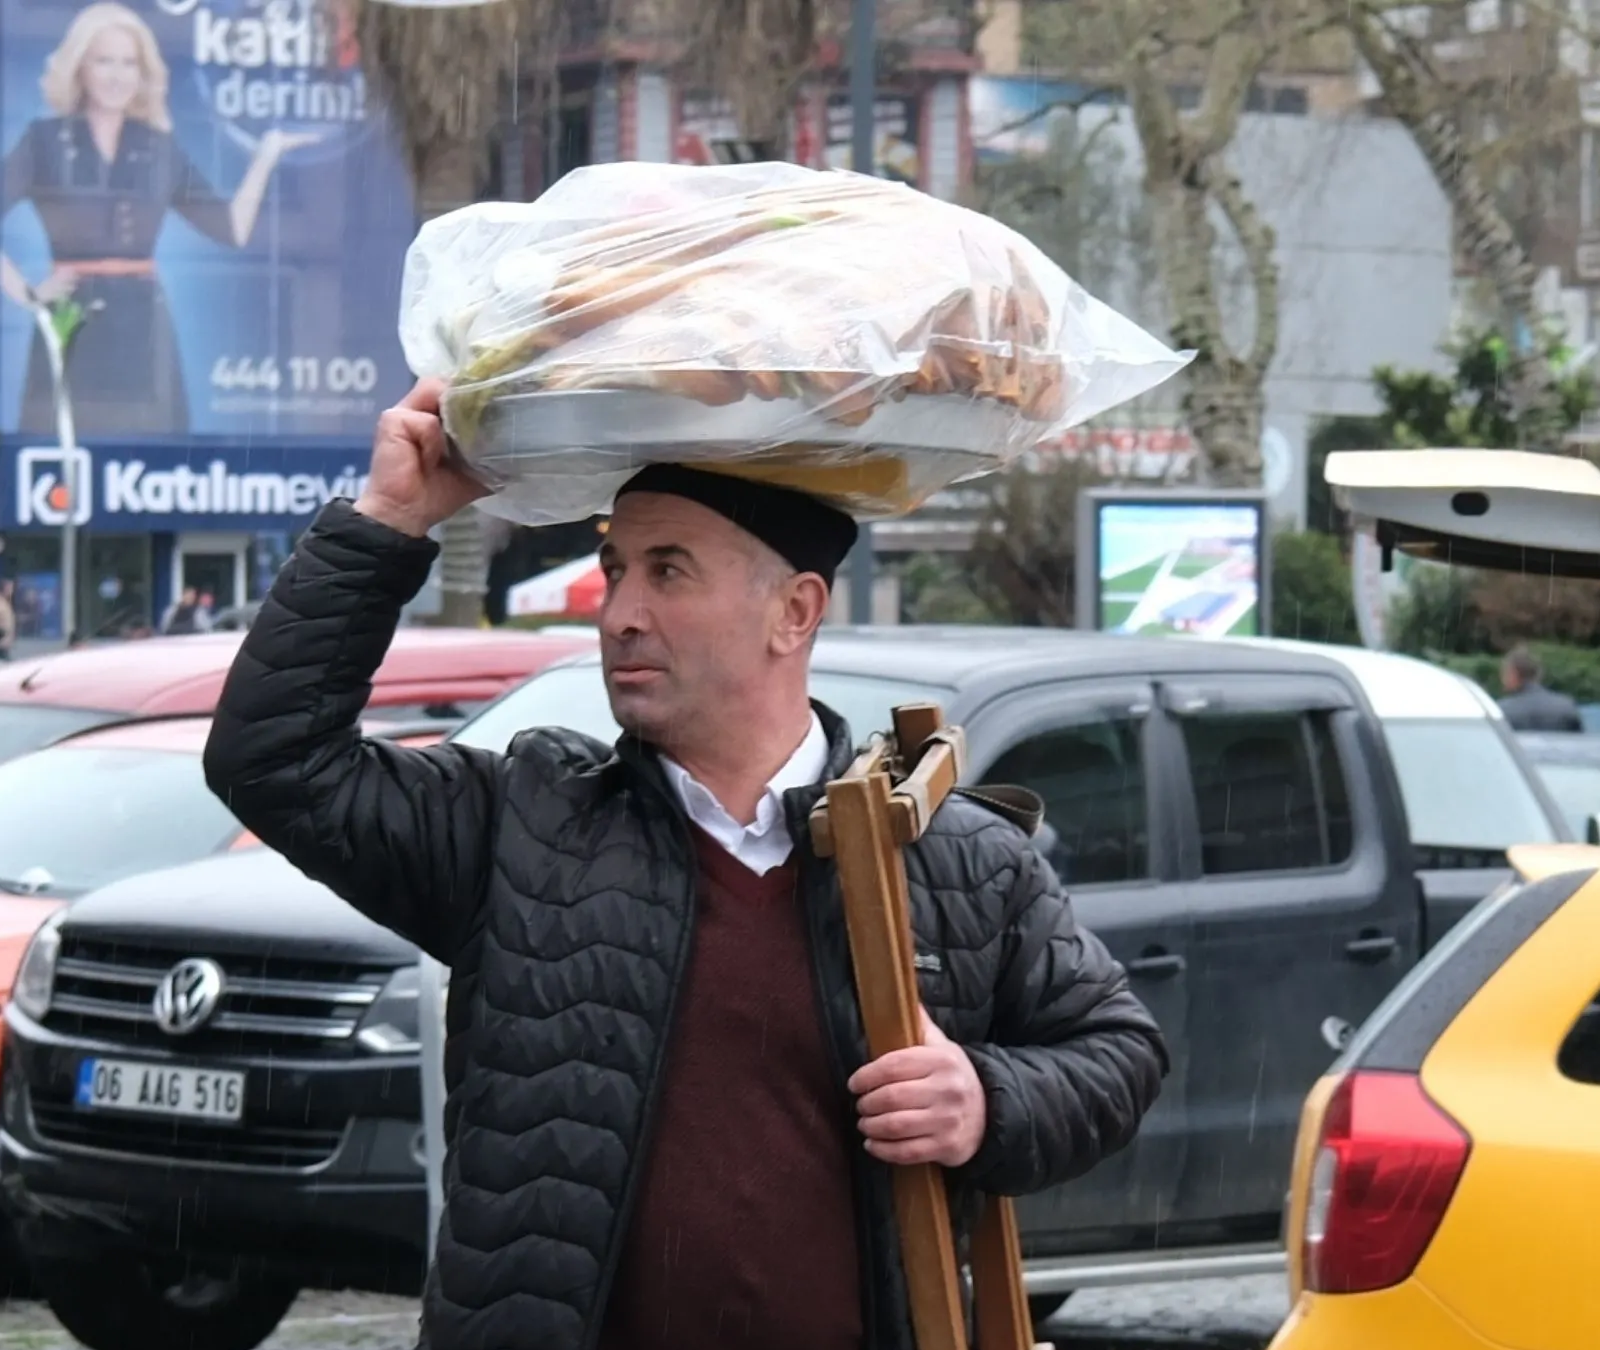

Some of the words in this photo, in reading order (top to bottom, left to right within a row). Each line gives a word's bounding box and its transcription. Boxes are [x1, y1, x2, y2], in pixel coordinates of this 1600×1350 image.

[211, 356, 282, 391] 444
[288, 356, 319, 391] 11
[326, 356, 377, 393] 00
[94, 1065, 122, 1100] 06
[137, 1070, 182, 1107] AAG
[194, 1075, 238, 1113] 516
